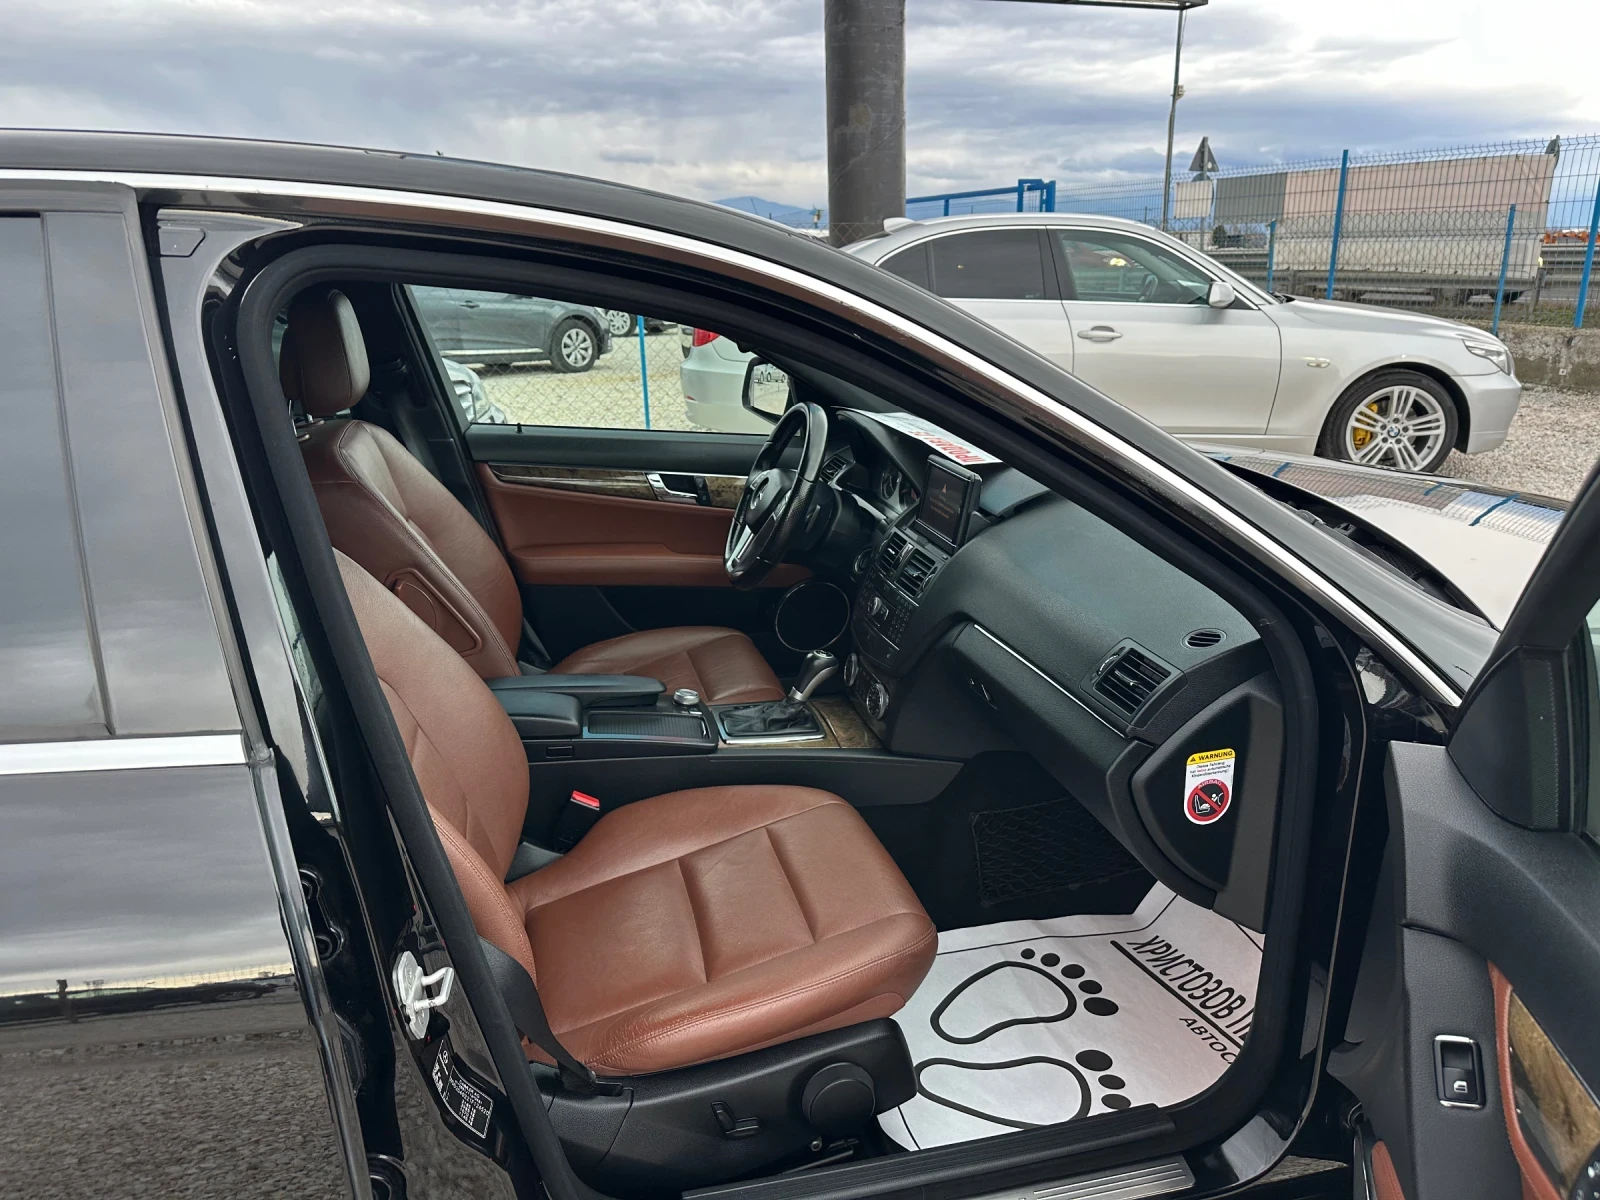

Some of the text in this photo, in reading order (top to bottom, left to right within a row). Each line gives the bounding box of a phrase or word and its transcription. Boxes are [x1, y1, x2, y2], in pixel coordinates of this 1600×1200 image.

[1198, 750, 1233, 761] WARNUNG
[1126, 935, 1247, 1019] ХРИСТОЗОВ
[1179, 1017, 1238, 1065] АВТОС
